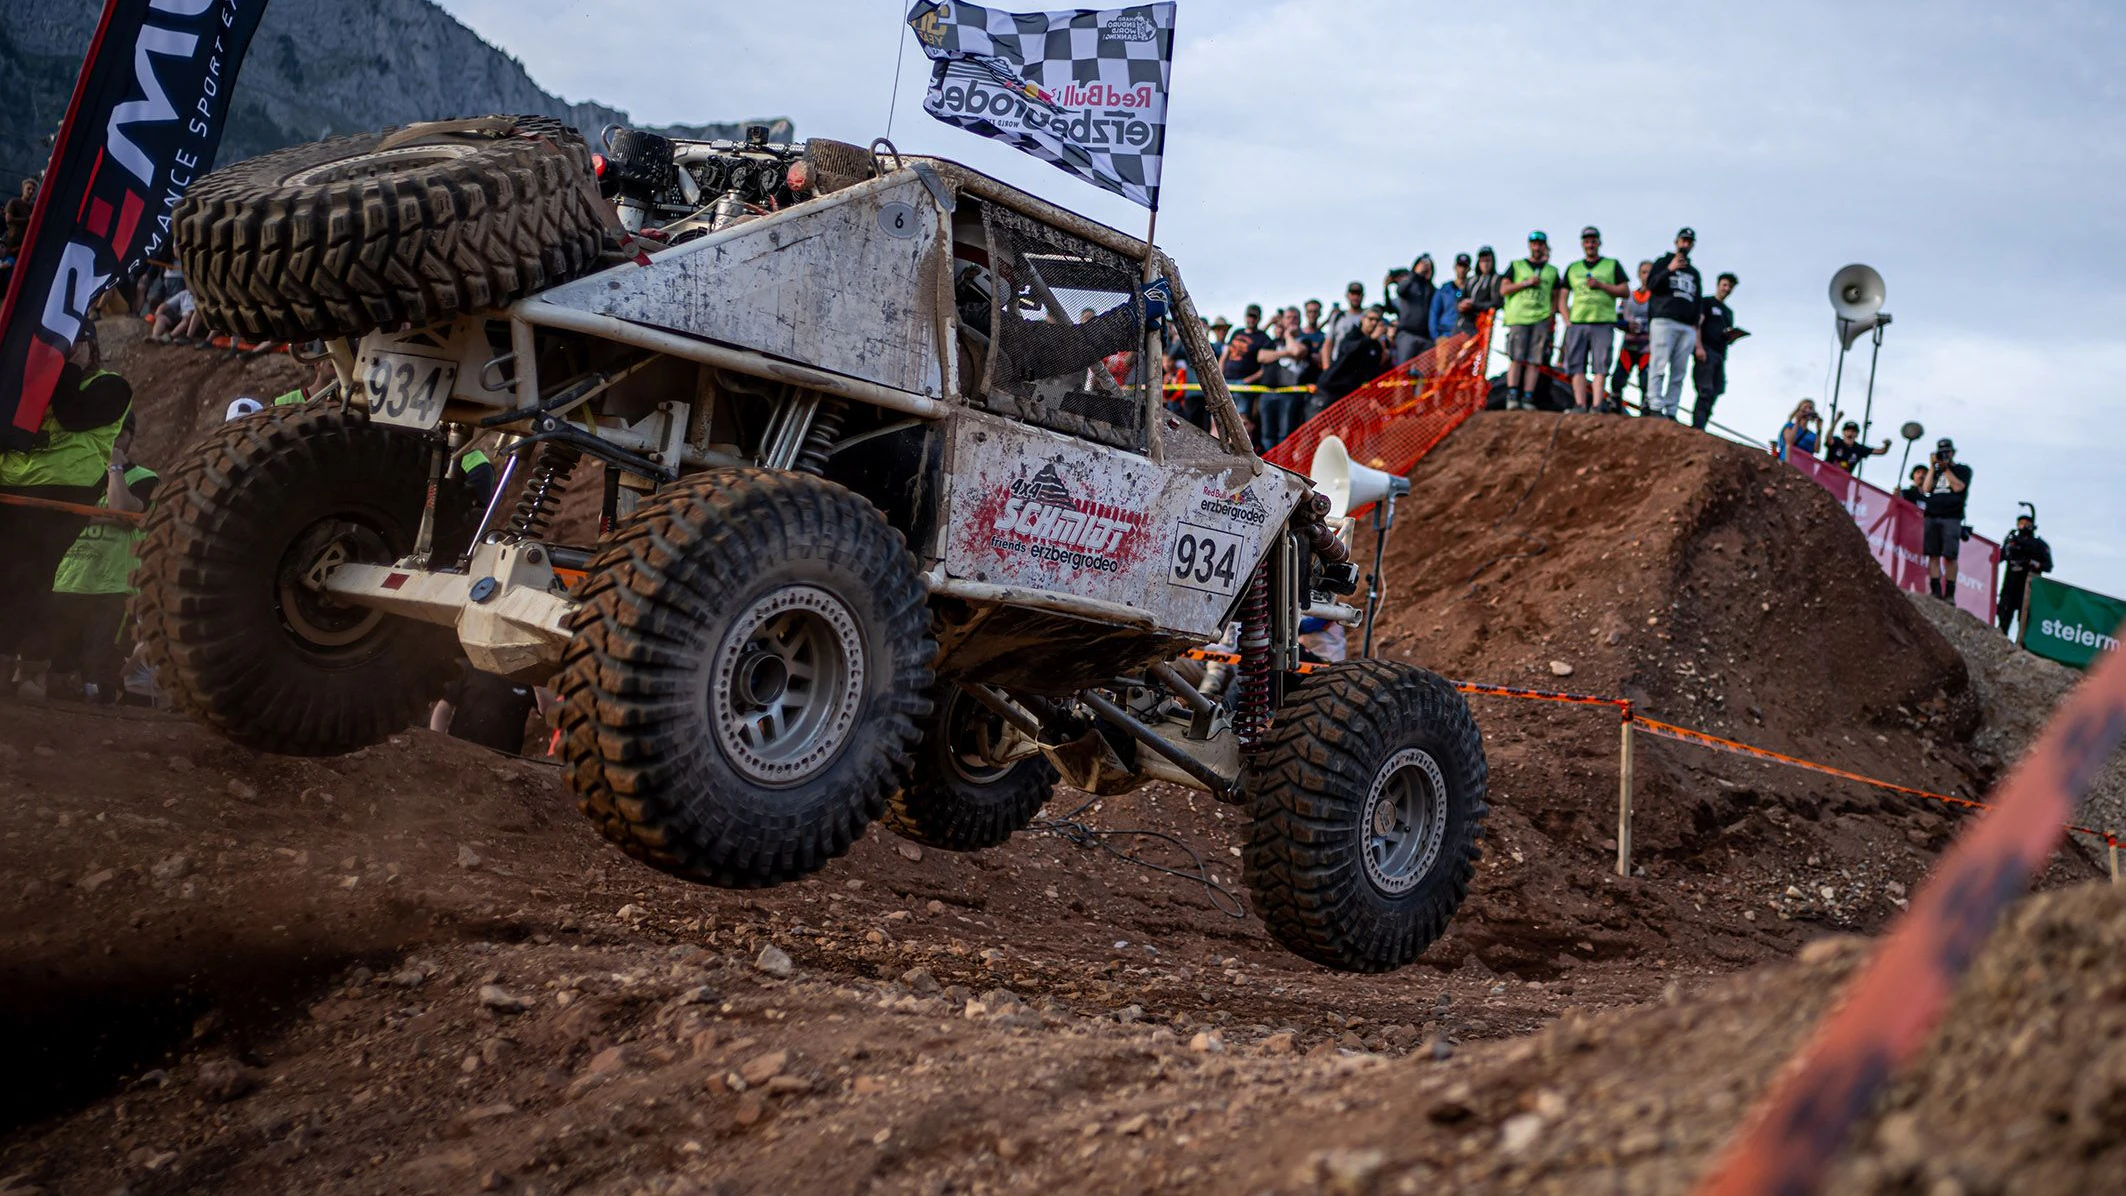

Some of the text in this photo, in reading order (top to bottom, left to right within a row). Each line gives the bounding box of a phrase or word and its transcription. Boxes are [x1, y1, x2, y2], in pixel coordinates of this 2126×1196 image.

[189, 35, 223, 137] SPORT
[894, 212, 904, 229] 6
[369, 360, 442, 421] 934
[1200, 499, 1265, 524] erzbergrodeo
[991, 536, 1118, 573] friends erzbergrodeo
[1175, 534, 1236, 587] 934
